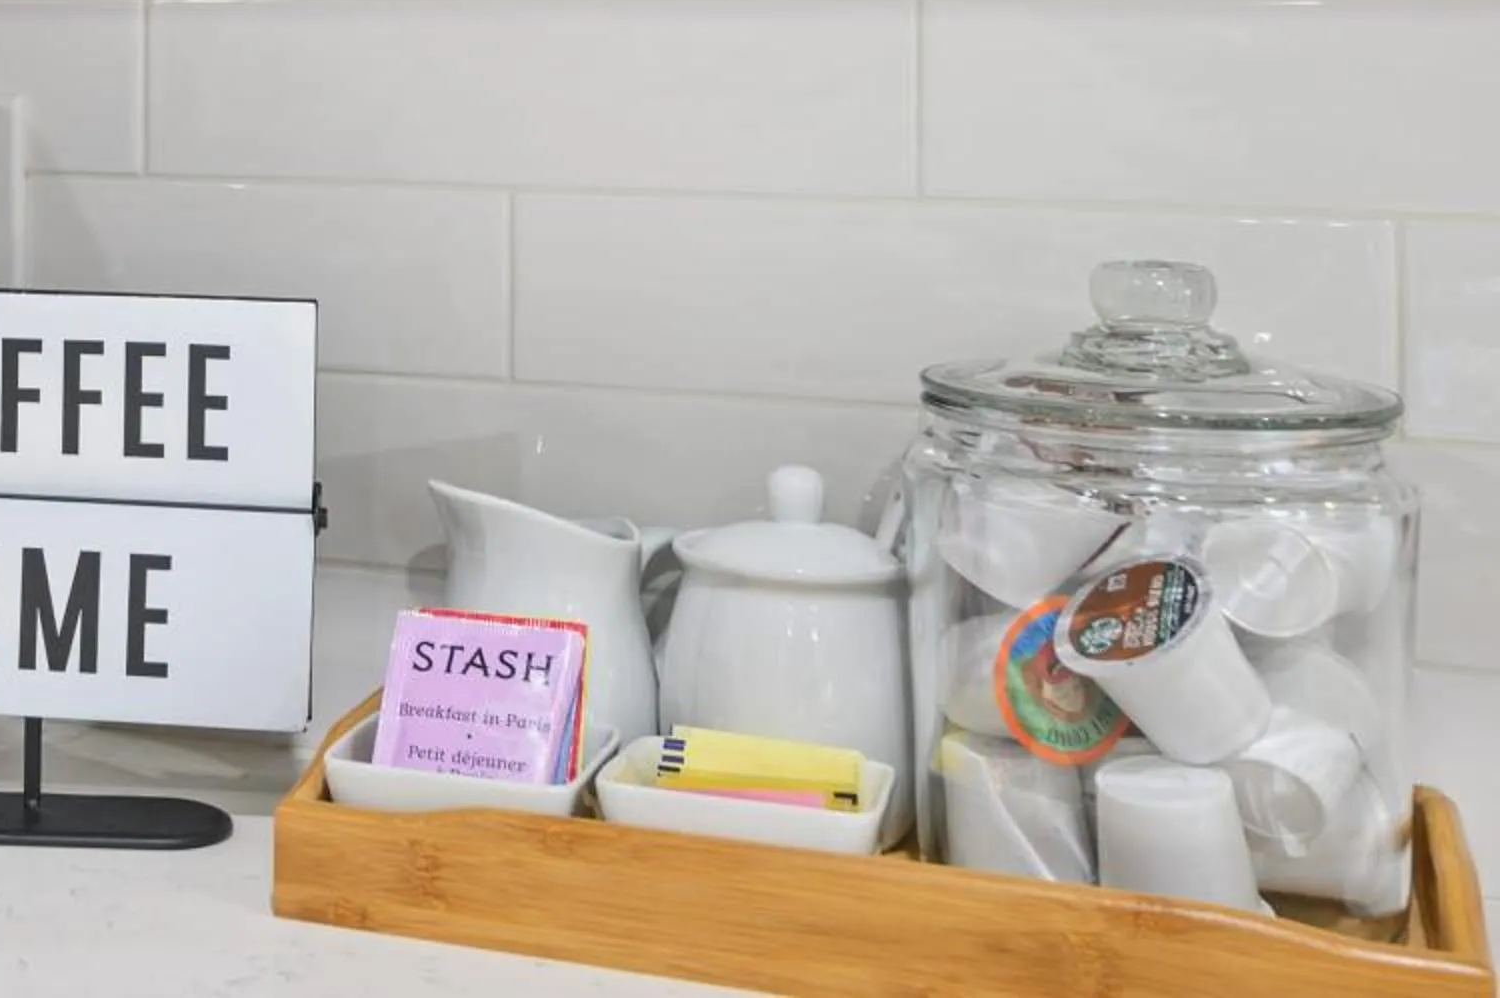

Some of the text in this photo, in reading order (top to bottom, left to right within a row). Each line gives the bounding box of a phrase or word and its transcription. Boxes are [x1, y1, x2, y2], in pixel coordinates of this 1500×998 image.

[412, 641, 554, 686] STASH
[399, 702, 552, 733] Breakfast in Paris
[407, 744, 446, 762] Petit
[451, 748, 529, 773] déjeuner
